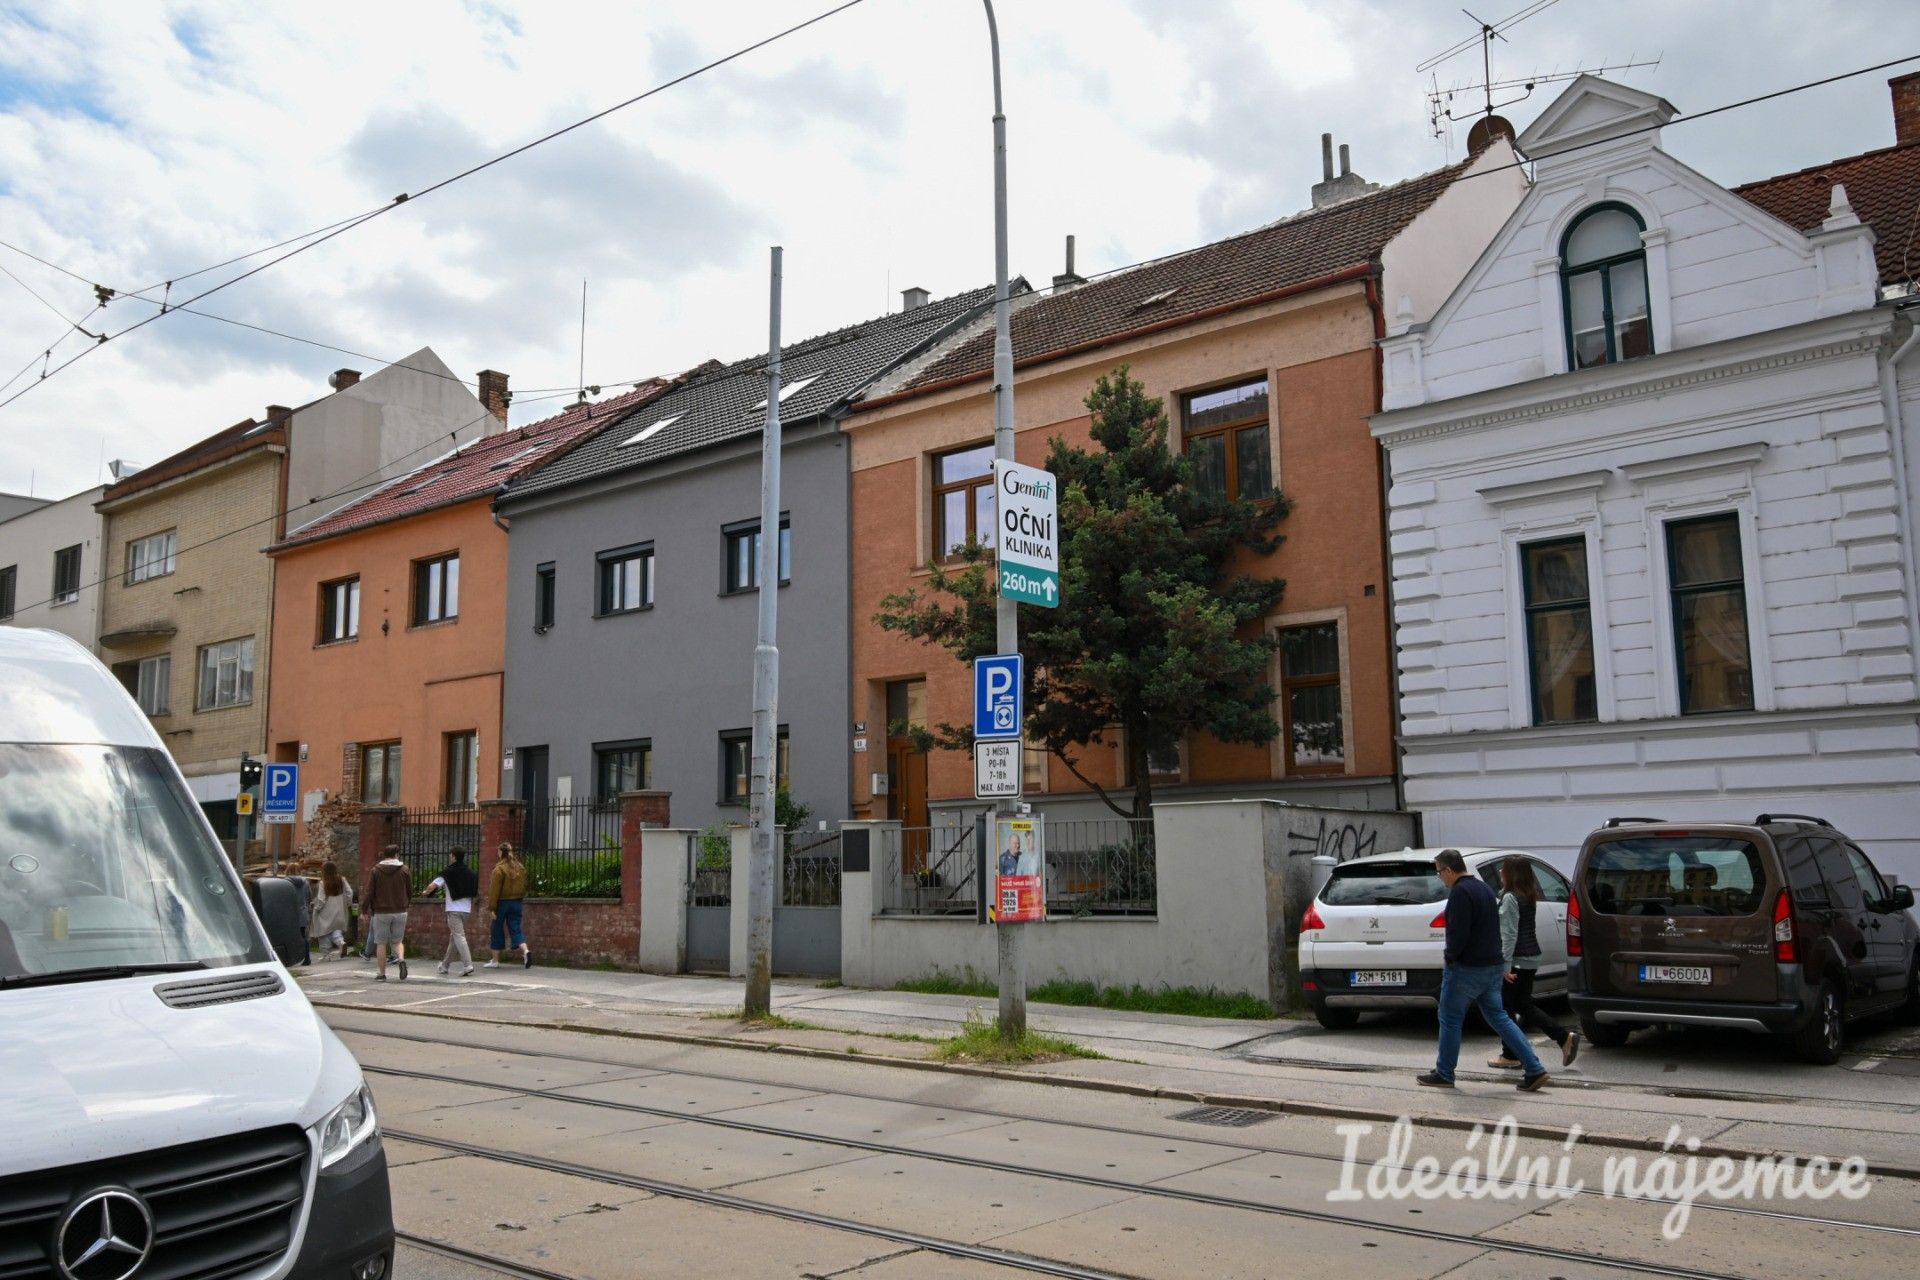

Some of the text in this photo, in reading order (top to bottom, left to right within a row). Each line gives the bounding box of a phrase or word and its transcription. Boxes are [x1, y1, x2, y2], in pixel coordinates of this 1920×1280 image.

[1003, 469, 1052, 500] Gemini
[1005, 506, 1052, 541] OČNÍ
[1005, 536, 1052, 560] KLINIKA
[986, 666, 1012, 712] P
[986, 744, 1010, 757] 3 MÍSTA
[988, 756, 1007, 768] PO-PÁ
[272, 769, 291, 797] P
[241, 799, 249, 809] P
[1357, 971, 1403, 982] 2SM 5181
